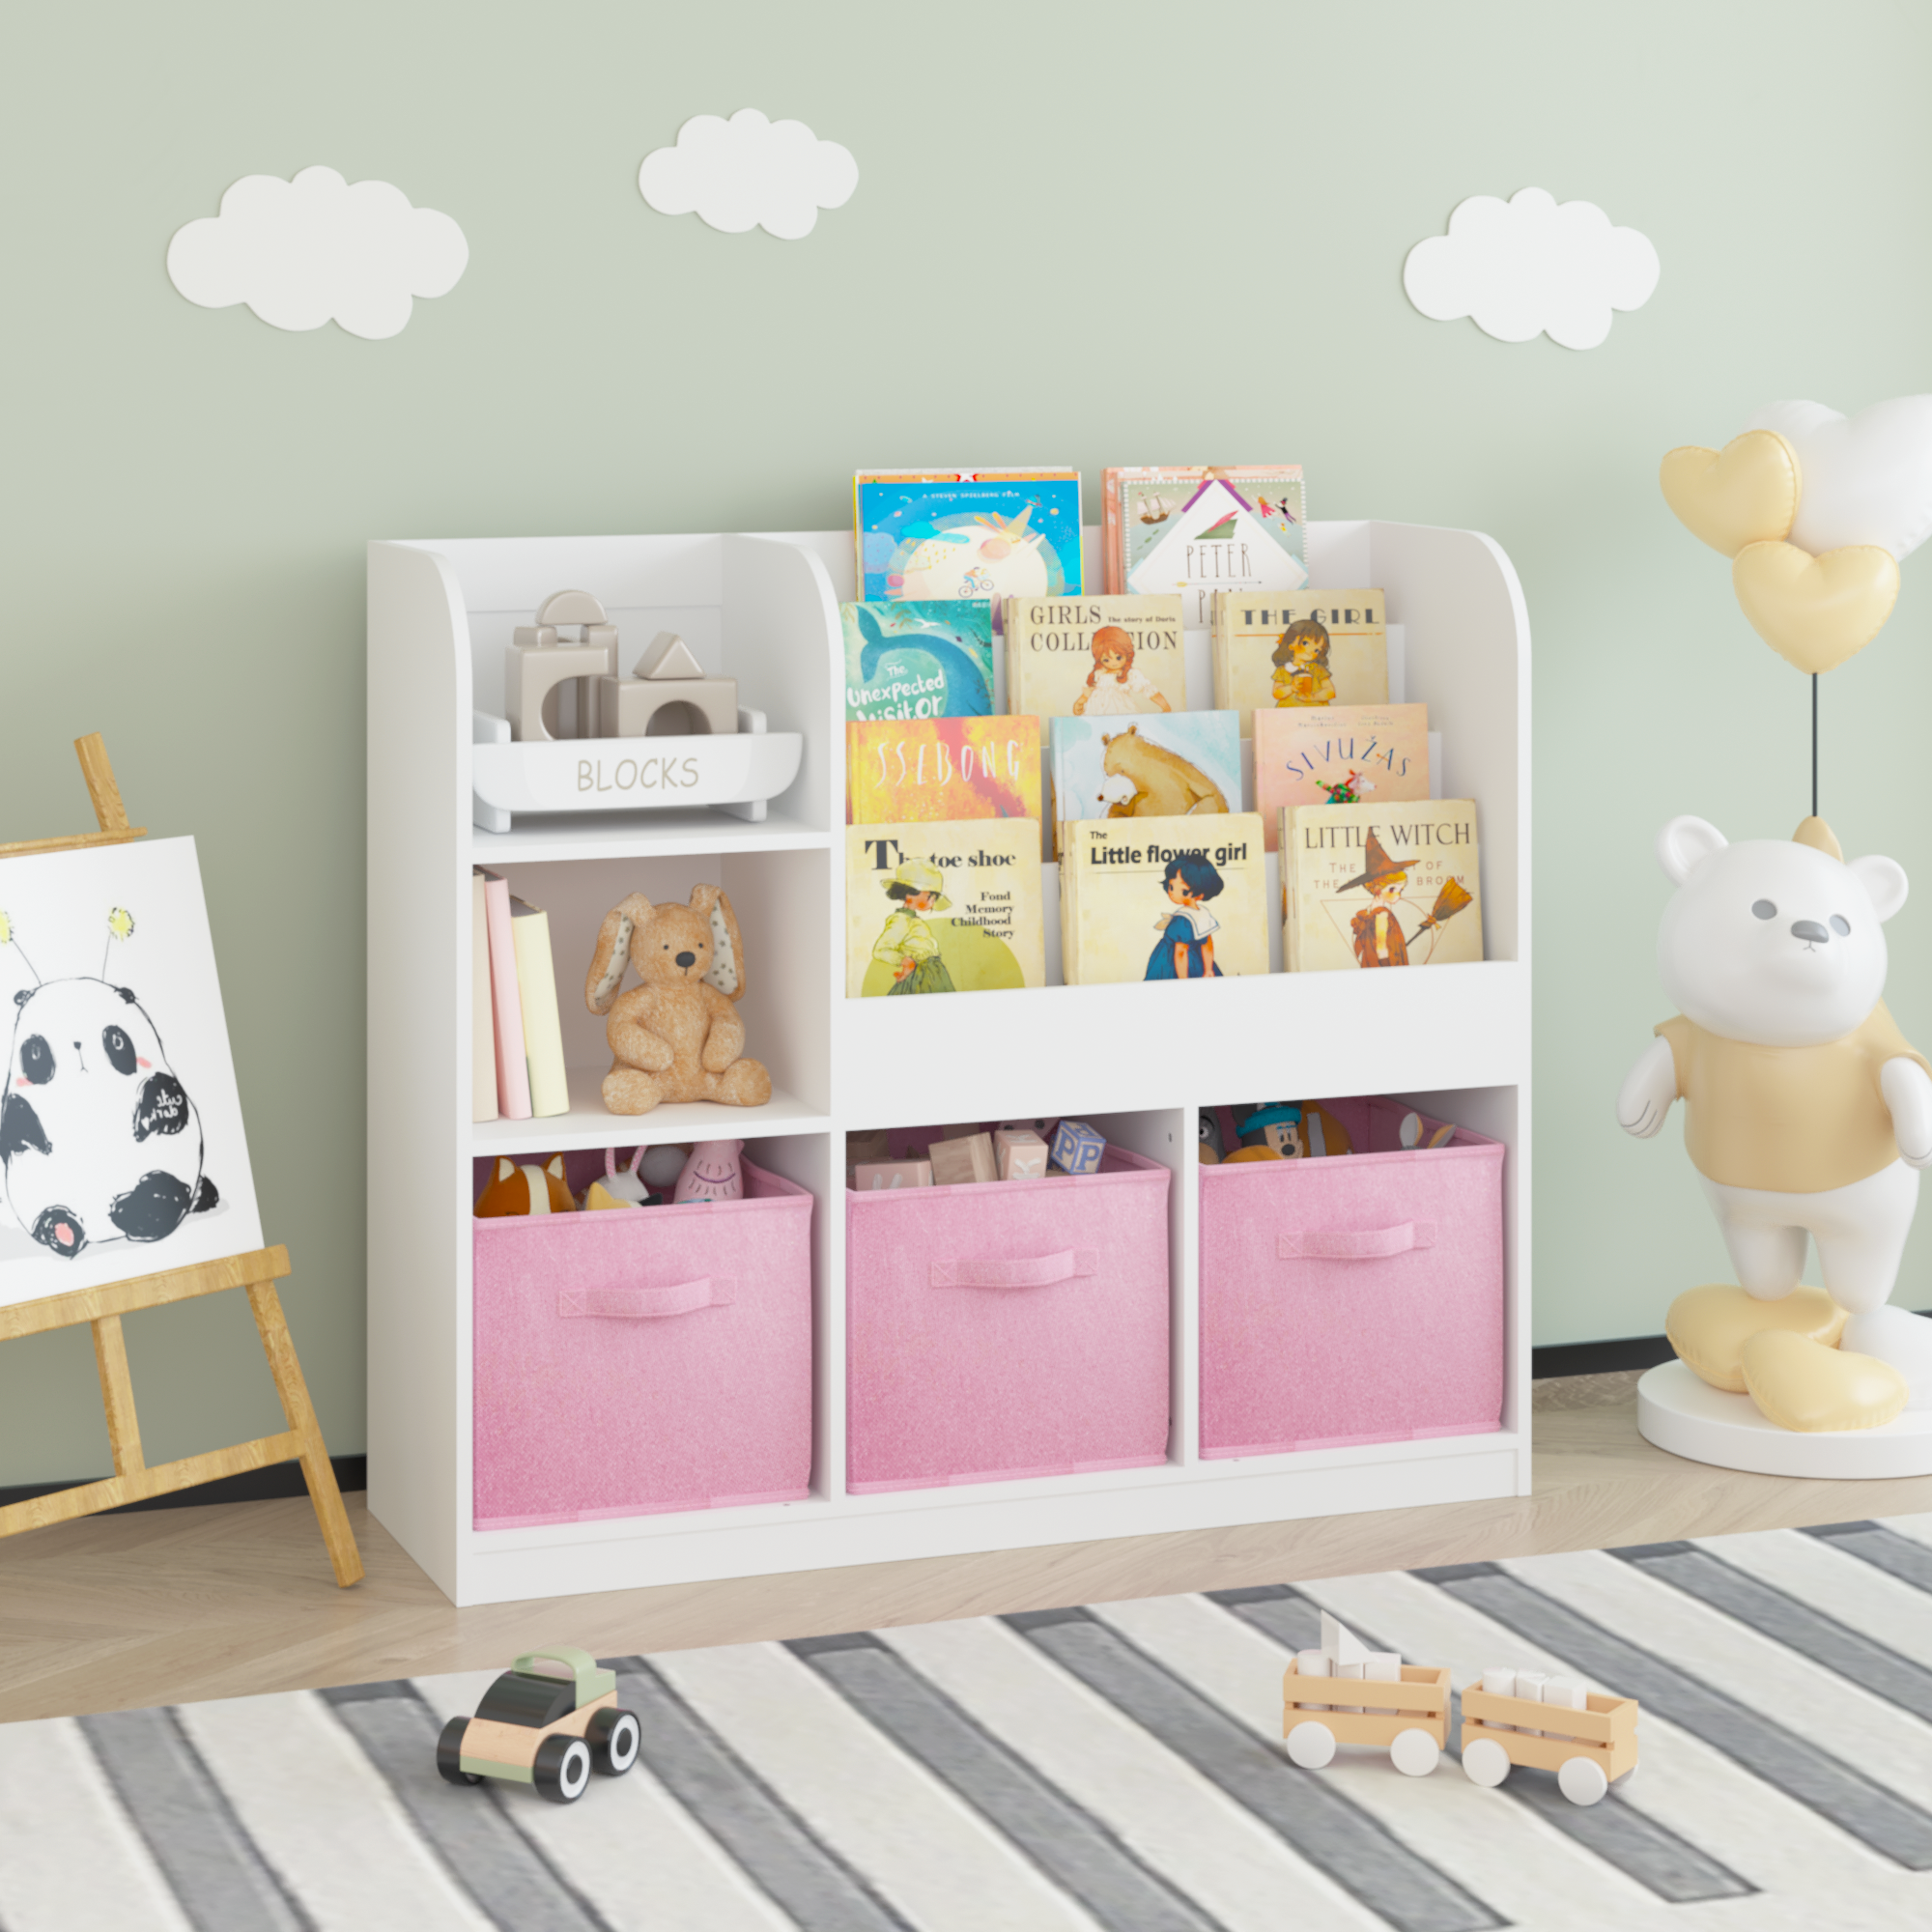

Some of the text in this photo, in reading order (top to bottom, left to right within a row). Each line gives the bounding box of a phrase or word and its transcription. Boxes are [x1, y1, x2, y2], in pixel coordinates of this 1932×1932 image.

[1186, 543, 1251, 578] PETER
[1030, 605, 1101, 625] GIRLS
[1240, 608, 1380, 625] THE GIRL
[1030, 630, 1178, 652] COLLION
[886, 663, 905, 677] The
[875, 739, 1019, 787] SSEBONG
[1286, 735, 1411, 781] SIVUŽAS
[578, 757, 698, 791] BLOCKS
[1090, 831, 1108, 839] The
[1390, 823, 1470, 846] WITCH
[928, 852, 962, 868] toe
[968, 849, 1016, 867] shoe
[1091, 842, 1247, 867] Little flower girl
[1329, 862, 1356, 873] THE
[1425, 861, 1442, 871] OF
[980, 891, 1010, 901] Fond
[965, 904, 1014, 915] Memory
[951, 913, 1011, 927] Childhood
[982, 928, 1014, 940] Story
[1055, 1128, 1075, 1160] P
[1076, 1144, 1100, 1171] P
